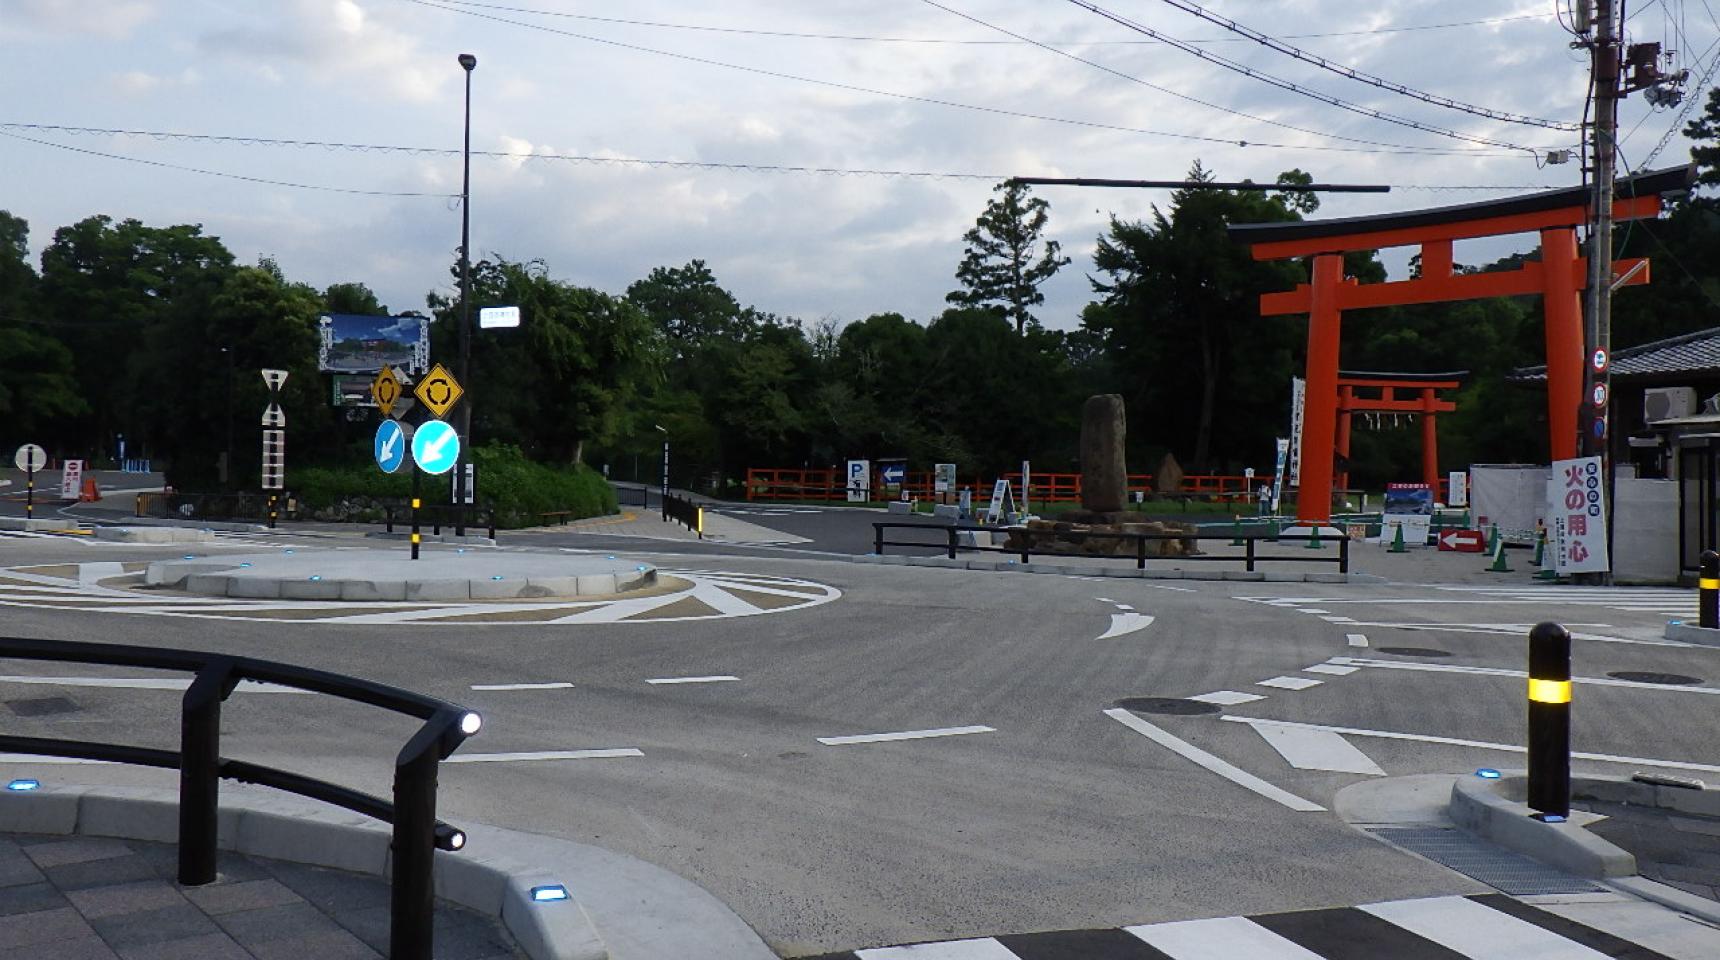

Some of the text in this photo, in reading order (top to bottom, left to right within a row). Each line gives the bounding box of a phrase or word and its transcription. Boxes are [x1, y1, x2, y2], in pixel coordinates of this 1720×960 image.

[851, 463, 863, 478] P
[1565, 464, 1589, 563] 火の用心
